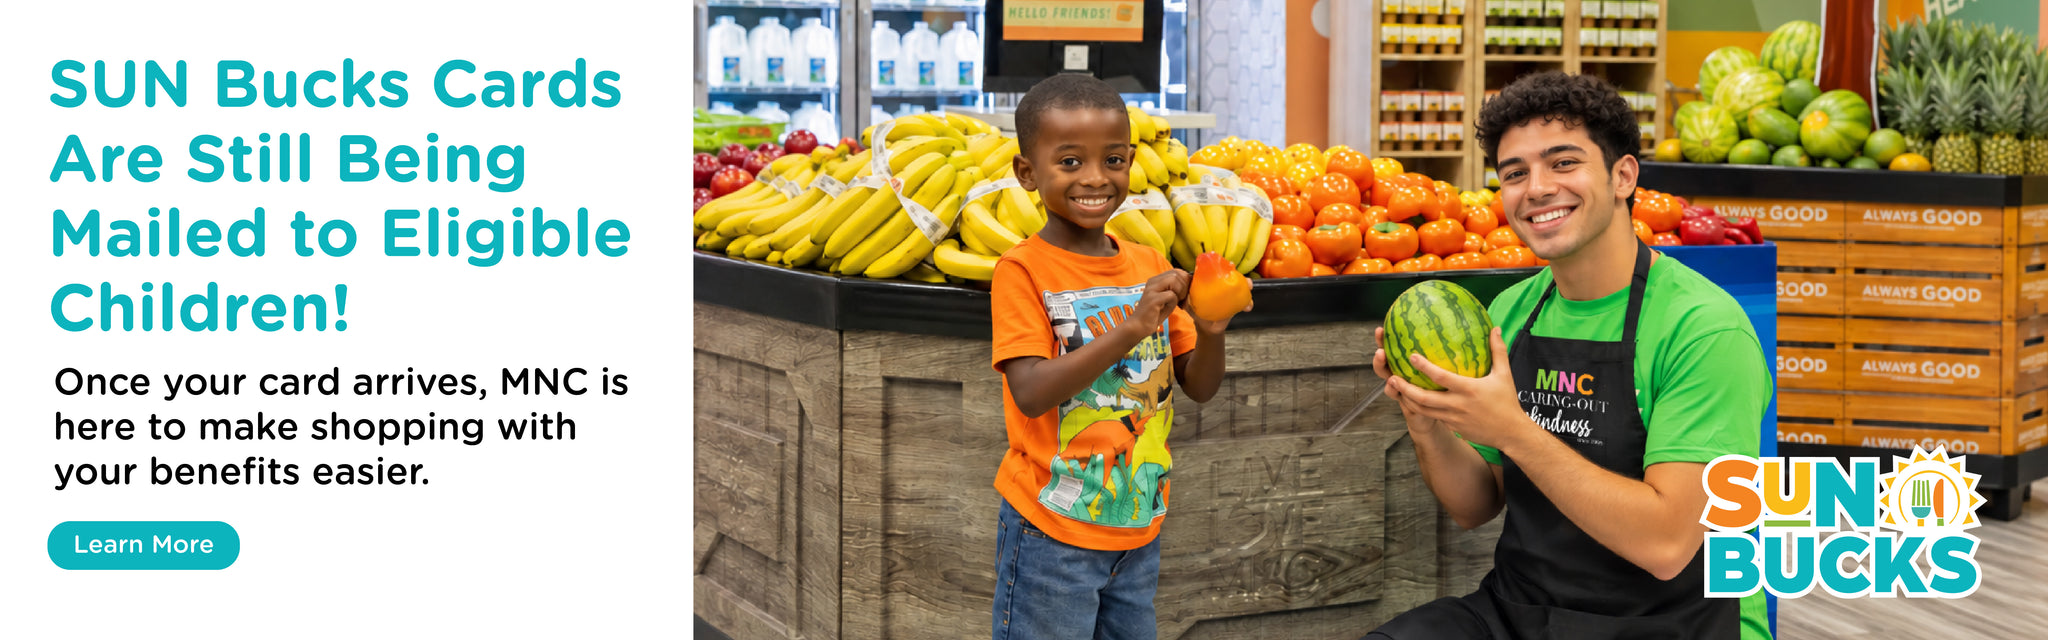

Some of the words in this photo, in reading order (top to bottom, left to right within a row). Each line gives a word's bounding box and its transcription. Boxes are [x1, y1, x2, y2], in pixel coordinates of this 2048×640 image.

[1008, 7, 1048, 19] HELLO
[1052, 7, 1111, 20] FRIENDS!
[1770, 205, 1828, 222] GOOD
[1863, 209, 1918, 223] ALWAYS
[1922, 209, 1982, 226] GOOD
[1863, 284, 1918, 299] ALWAYS
[1922, 285, 1982, 302] GOOD
[1862, 360, 1917, 375] ALWAYS
[1921, 361, 1981, 379] GOOD
[1536, 368, 1594, 395] MNC
[1518, 390, 1609, 413] CARING-OUT
